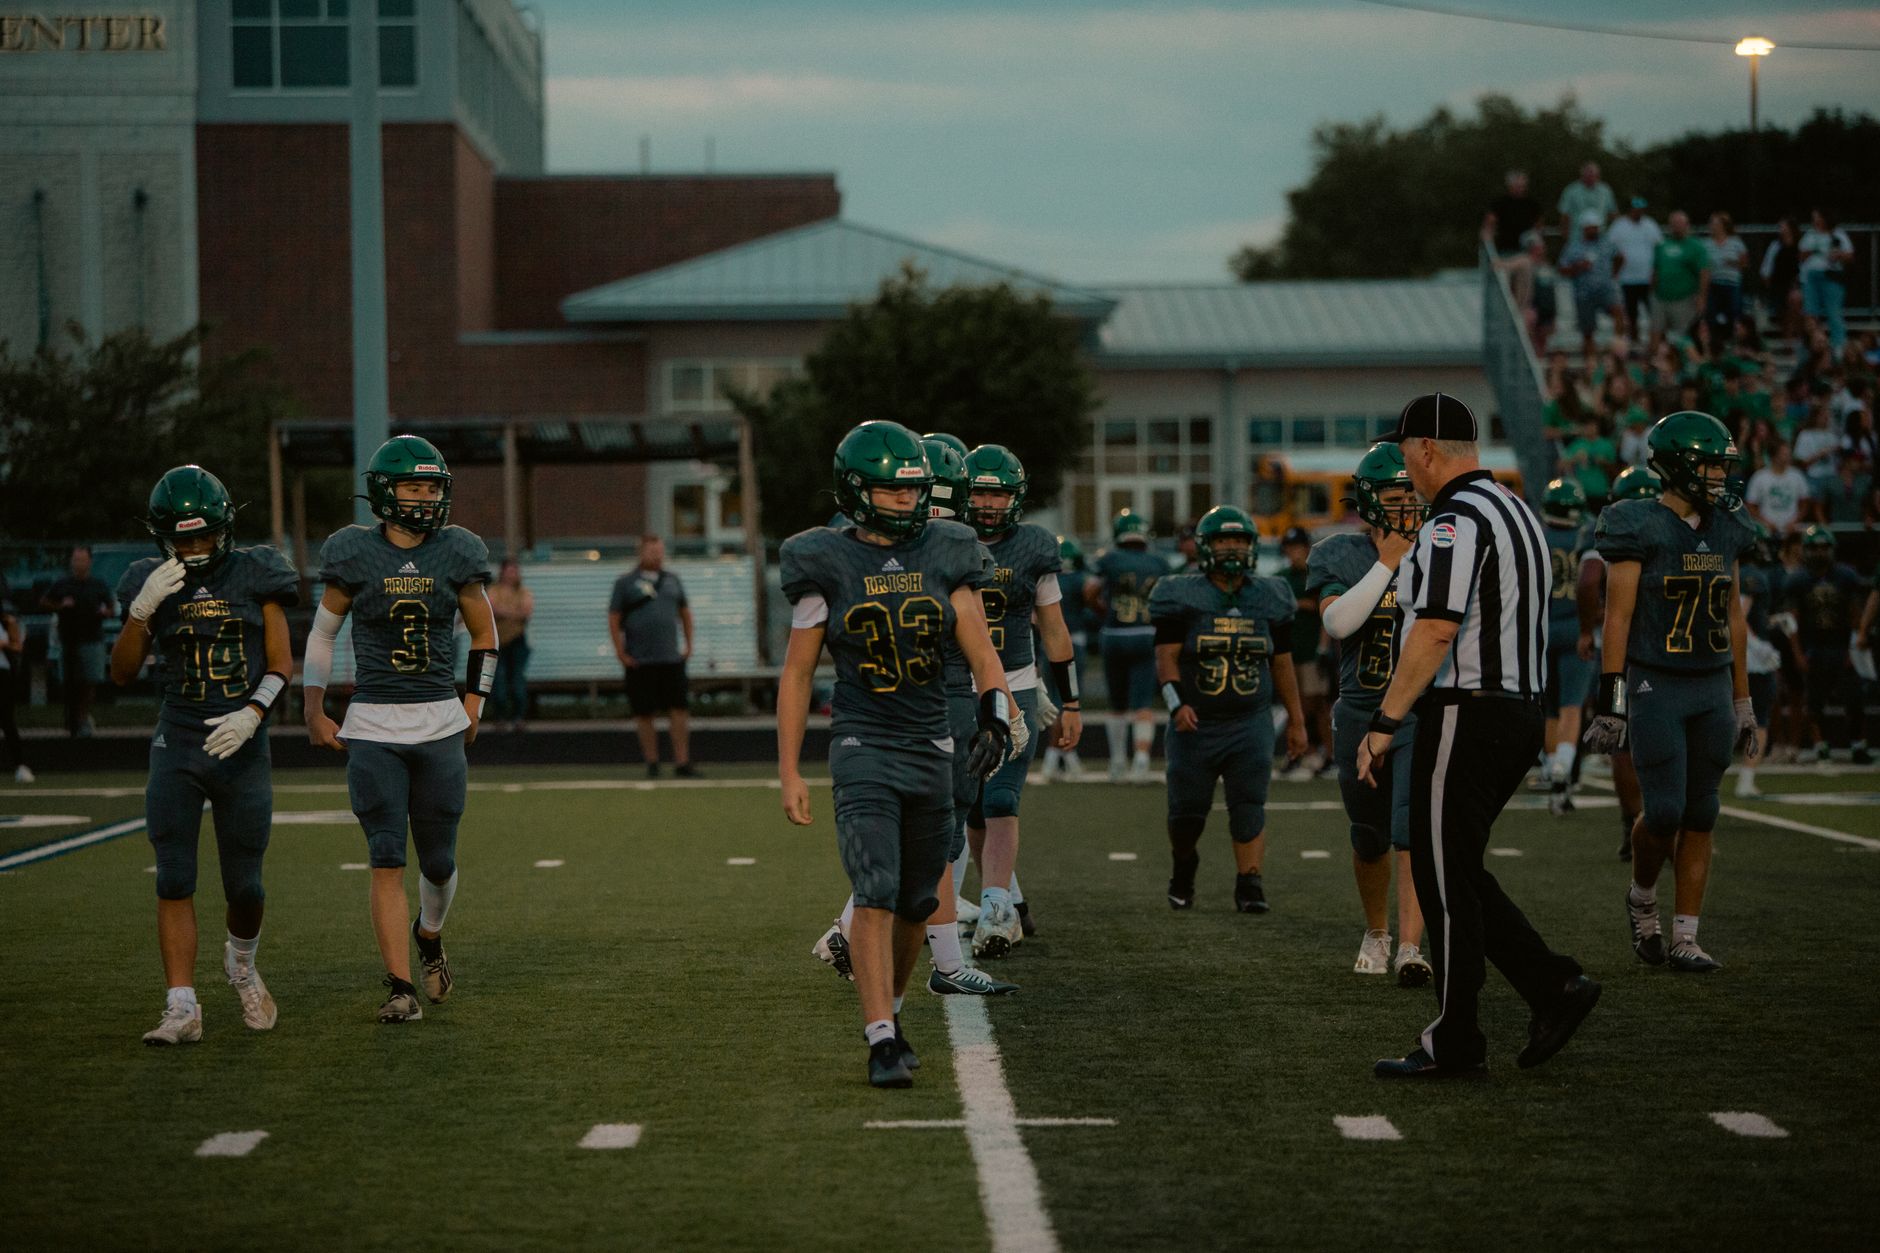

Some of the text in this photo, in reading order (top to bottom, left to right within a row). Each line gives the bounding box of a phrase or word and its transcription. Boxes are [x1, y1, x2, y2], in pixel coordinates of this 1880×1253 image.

[0, 15, 167, 52] ENTER
[1683, 553, 1725, 571] IRISH
[384, 577, 434, 595] IRISH
[864, 572, 923, 596] IRISH
[179, 600, 232, 619] IRISH
[389, 599, 431, 674] 3
[843, 596, 943, 694] 33
[175, 618, 250, 701] 14
[1195, 634, 1268, 696] 55
